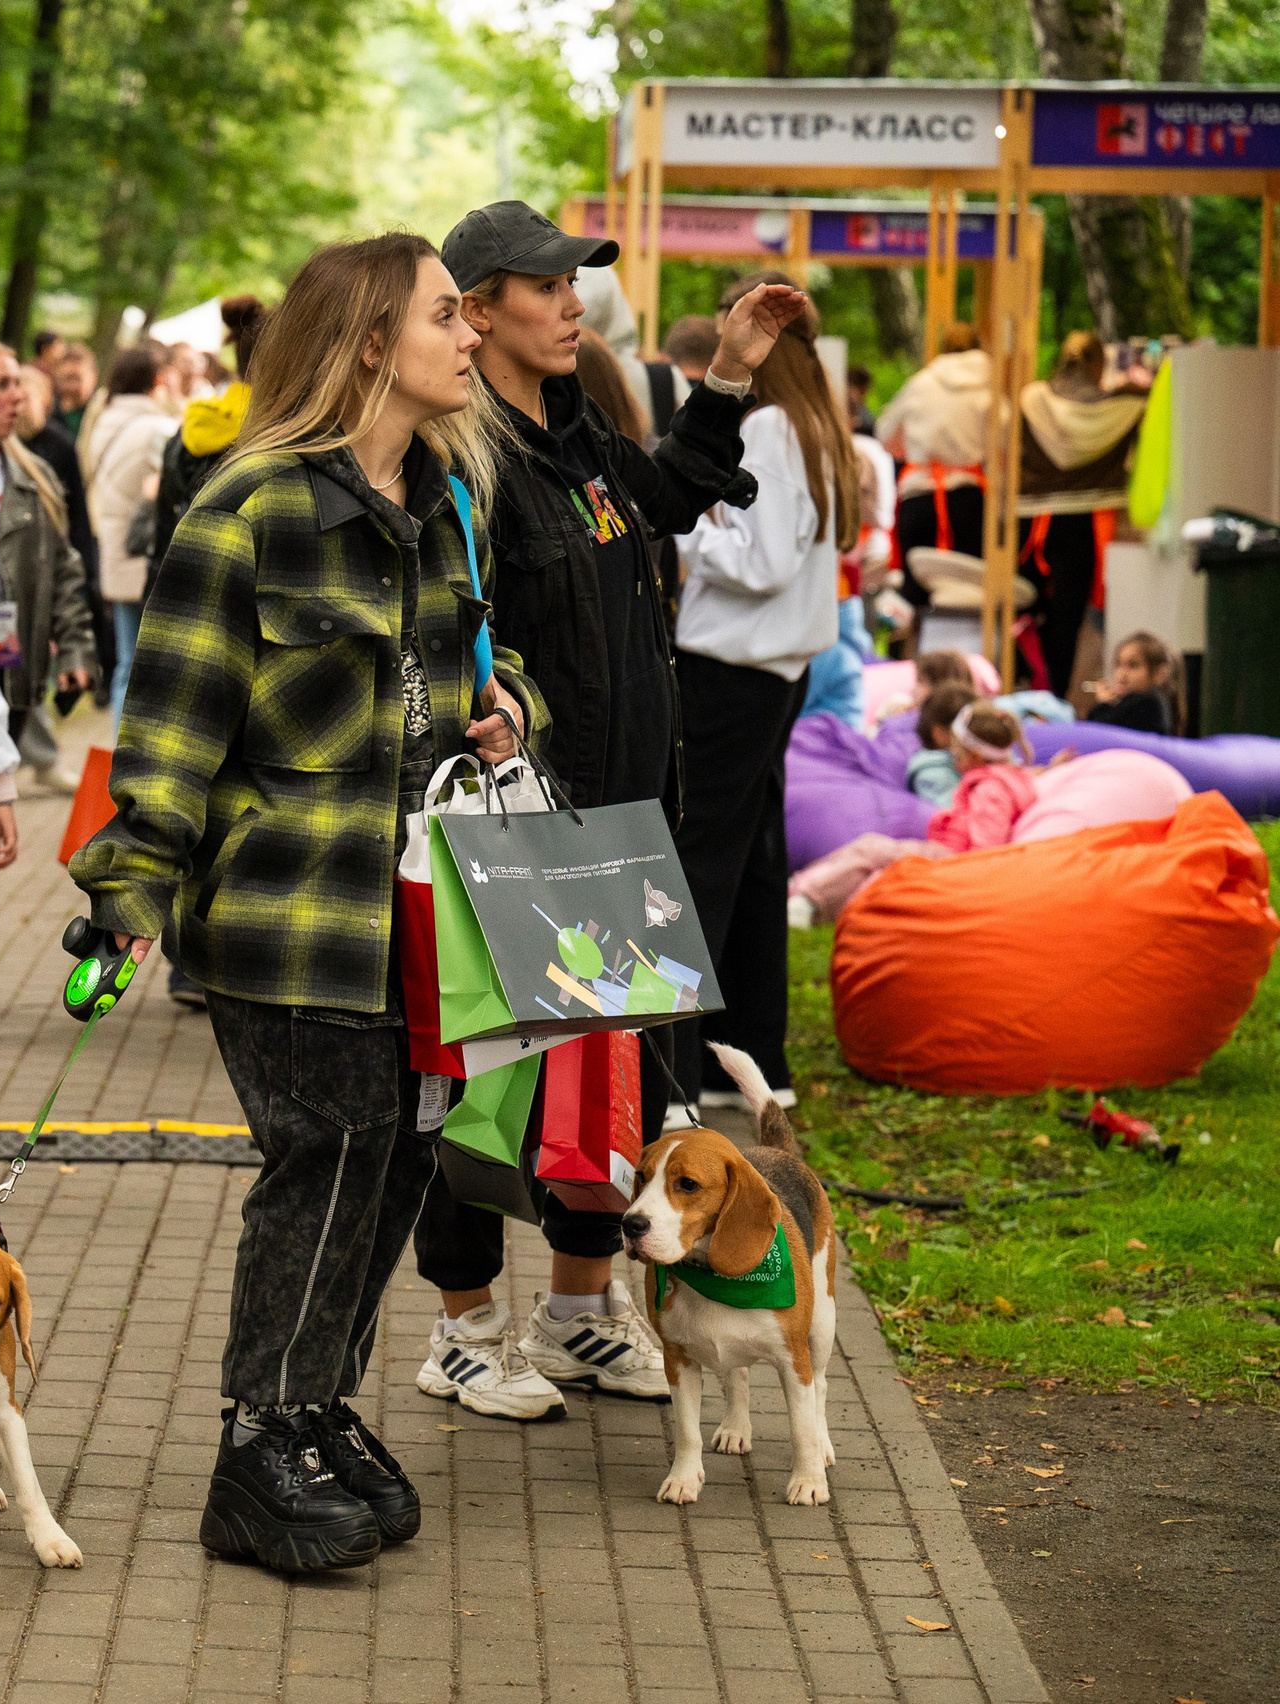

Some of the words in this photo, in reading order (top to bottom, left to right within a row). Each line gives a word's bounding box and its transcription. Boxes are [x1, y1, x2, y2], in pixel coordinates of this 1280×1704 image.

[685, 112, 976, 141] МАСТЕР-КЛАСС
[541, 867, 569, 875] ПЕРЕДОВЫЕ
[569, 863, 600, 873] ИННОВАЦИИ
[600, 858, 625, 868] МИРОВОЙ
[554, 871, 592, 881] БЛАГОПОЛУЧИЯ
[592, 867, 621, 877] ПИТОМЦЕВ
